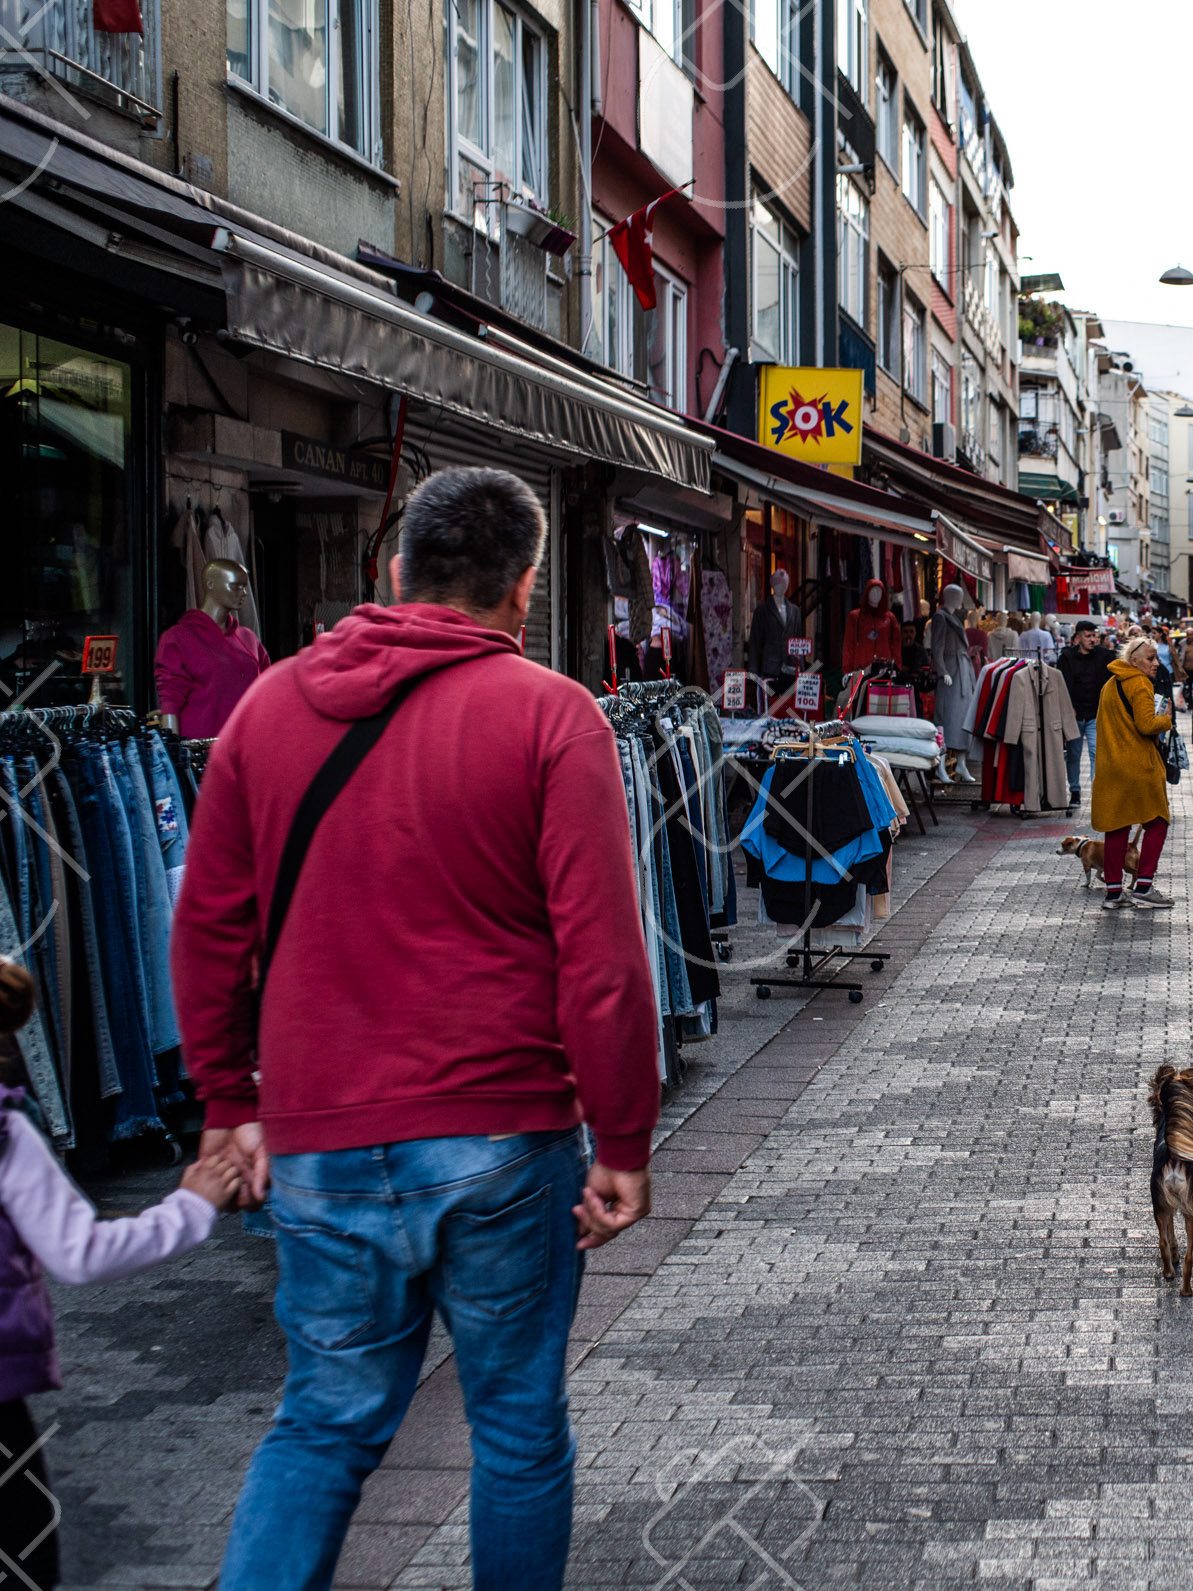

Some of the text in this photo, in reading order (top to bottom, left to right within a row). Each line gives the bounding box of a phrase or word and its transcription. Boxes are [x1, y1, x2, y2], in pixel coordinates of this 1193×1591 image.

[770, 400, 854, 445] ŞOK
[294, 441, 345, 474] CANAN
[88, 647, 111, 668] 199
